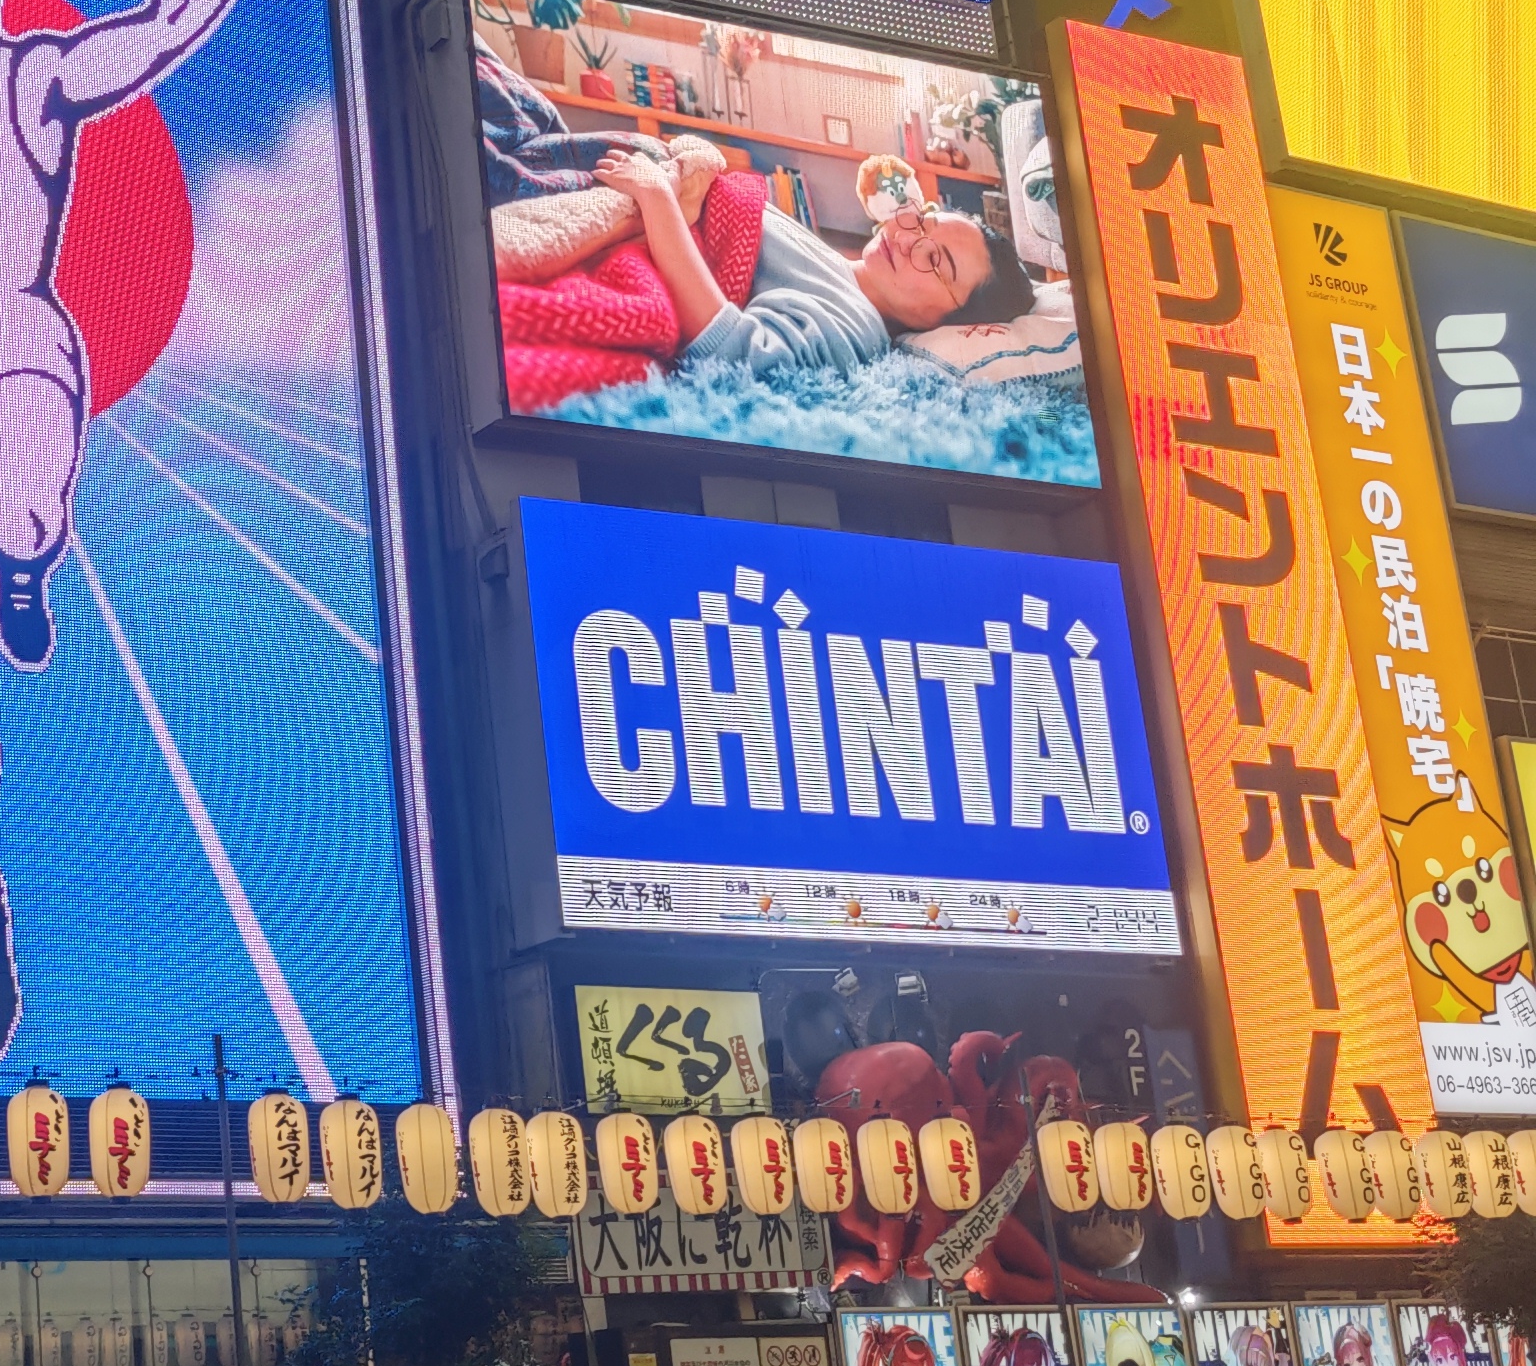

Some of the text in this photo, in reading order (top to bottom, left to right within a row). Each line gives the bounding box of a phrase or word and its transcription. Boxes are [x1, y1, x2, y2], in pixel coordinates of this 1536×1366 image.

[1309, 272, 1369, 296] JS GROUP
[581, 879, 674, 913] 天気予報
[615, 1002, 733, 1098] くくる
[273, 1100, 305, 1187] なんばマルイ
[355, 1107, 380, 1199] なんばマルイ
[1445, 1137, 1471, 1206] 山根康広
[1487, 1138, 1514, 1207] 山根康広
